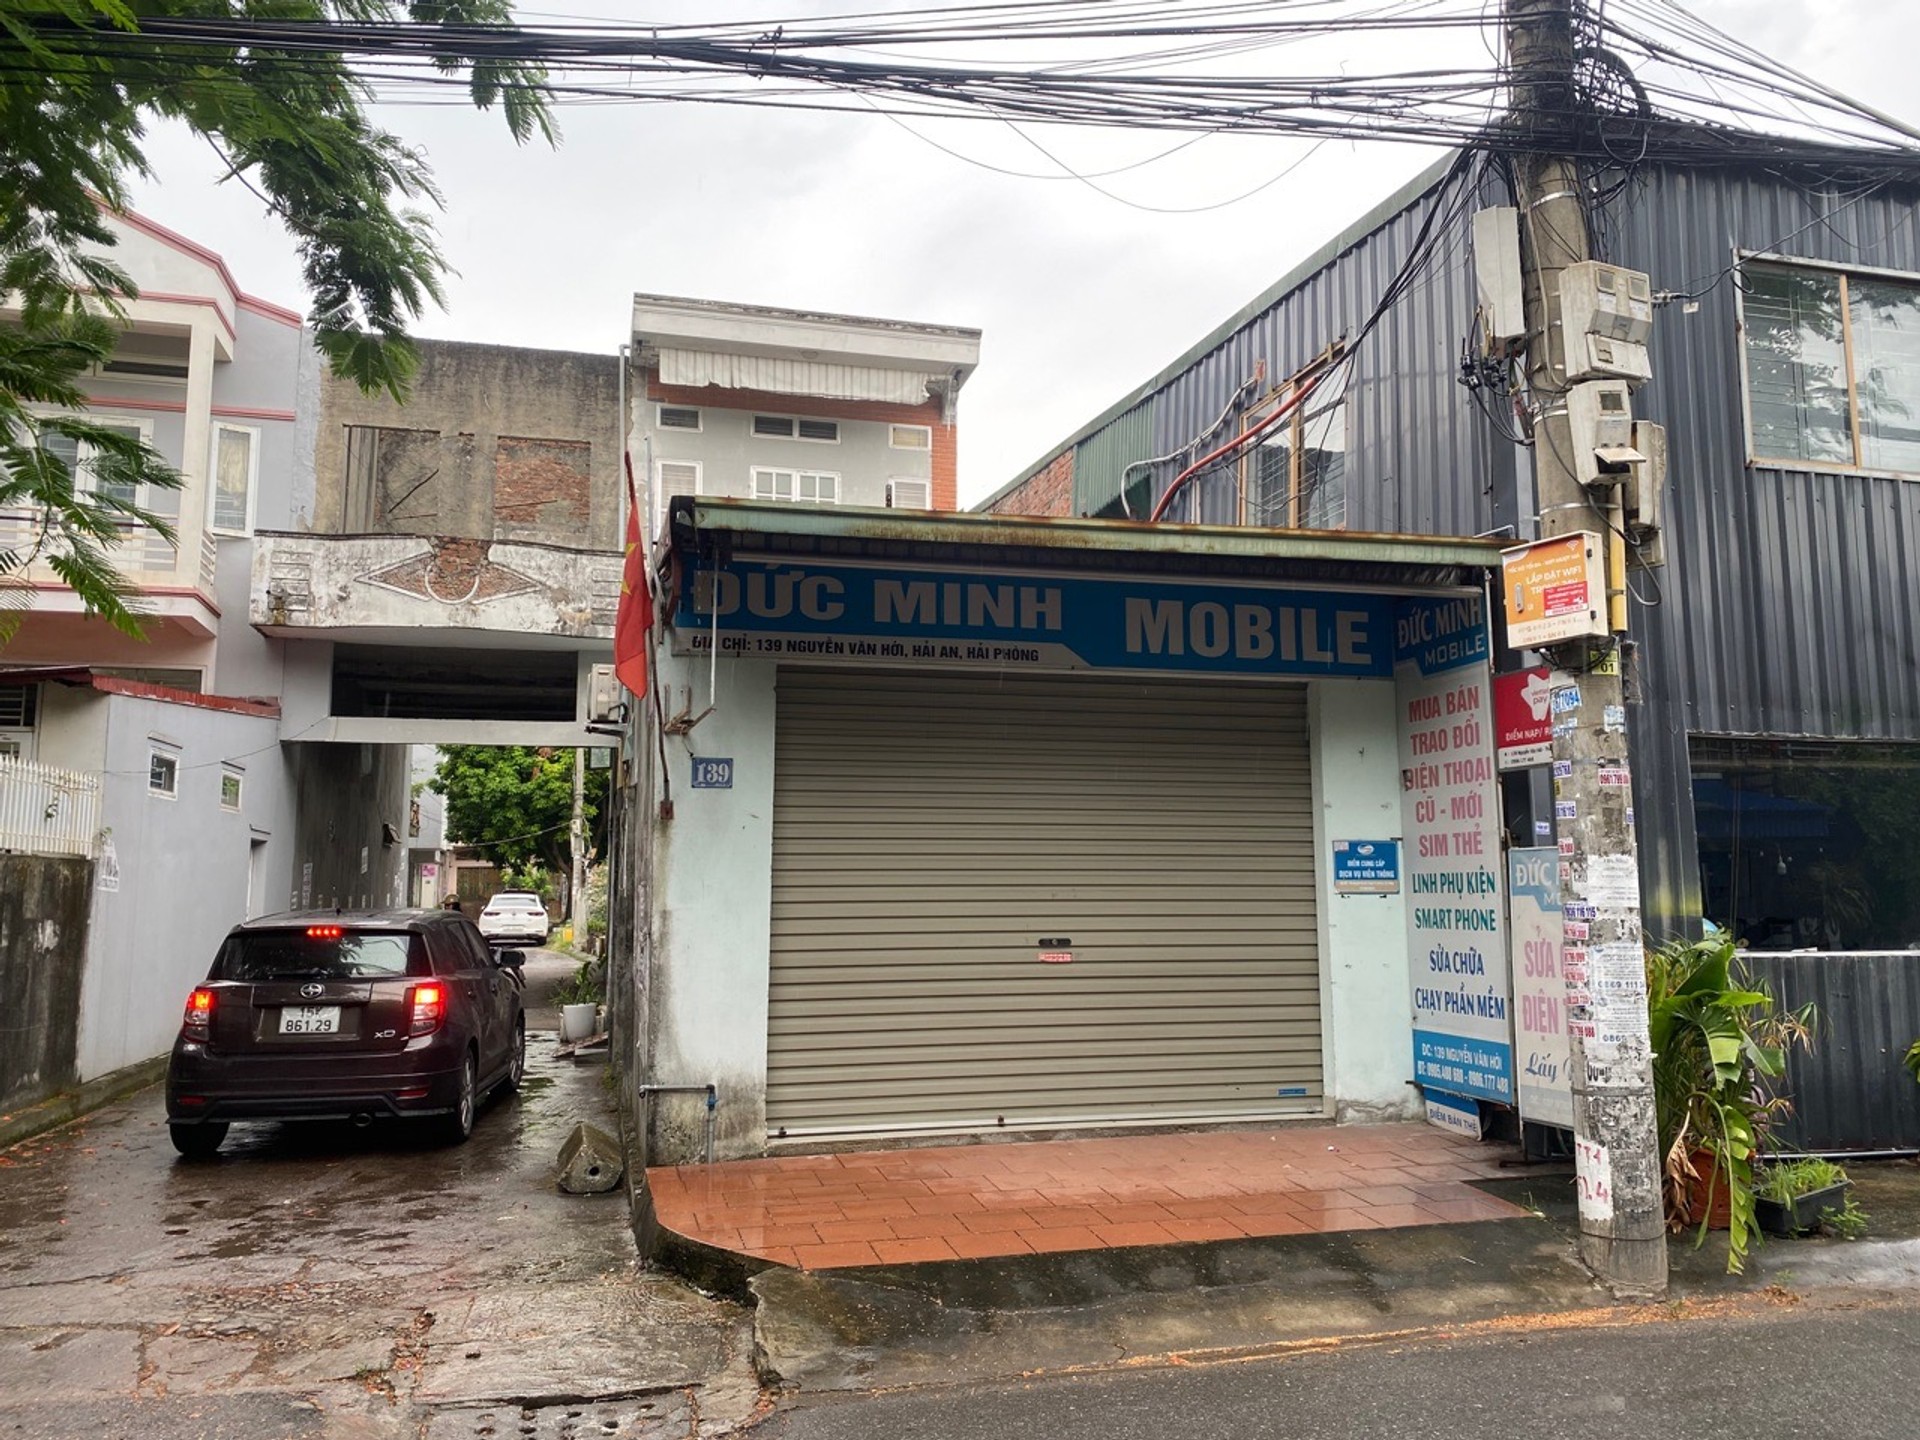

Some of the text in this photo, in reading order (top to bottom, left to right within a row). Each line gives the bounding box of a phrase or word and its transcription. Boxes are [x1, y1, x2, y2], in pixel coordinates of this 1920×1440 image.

[692, 564, 1373, 666] ĐỨC MINH MOBILE
[1398, 598, 1482, 650] ĐỨC MINH
[756, 638, 782, 653] 139
[848, 640, 877, 656] VĂN
[912, 641, 936, 658] HẢI
[940, 646, 963, 660] AN,
[967, 644, 990, 660] HẢI
[994, 646, 1040, 662] PHÒNG
[1424, 633, 1486, 665] MOBILE
[1408, 685, 1480, 723] MUA BÁN
[1410, 713, 1480, 756] TRAO ĐỔI
[695, 763, 729, 783] 139
[1402, 756, 1492, 794] ĐIỆN THOẠI
[1415, 795, 1436, 824] CŨ
[1450, 790, 1483, 821] MỚI
[1418, 823, 1483, 857] SIM THẺ
[1412, 865, 1496, 900] LINH PHỤ KIỆN
[1515, 858, 1553, 887] ĐỨC
[1415, 908, 1497, 932] SMART PHONE
[1429, 943, 1485, 976] SỬA CHỮA
[1523, 927, 1557, 979] SỬA
[1415, 987, 1443, 1016] CHẠY
[1522, 989, 1559, 1042] ĐIỆN
[285, 1019, 333, 1032] 861.29
[1525, 1053, 1558, 1084] Lấy
